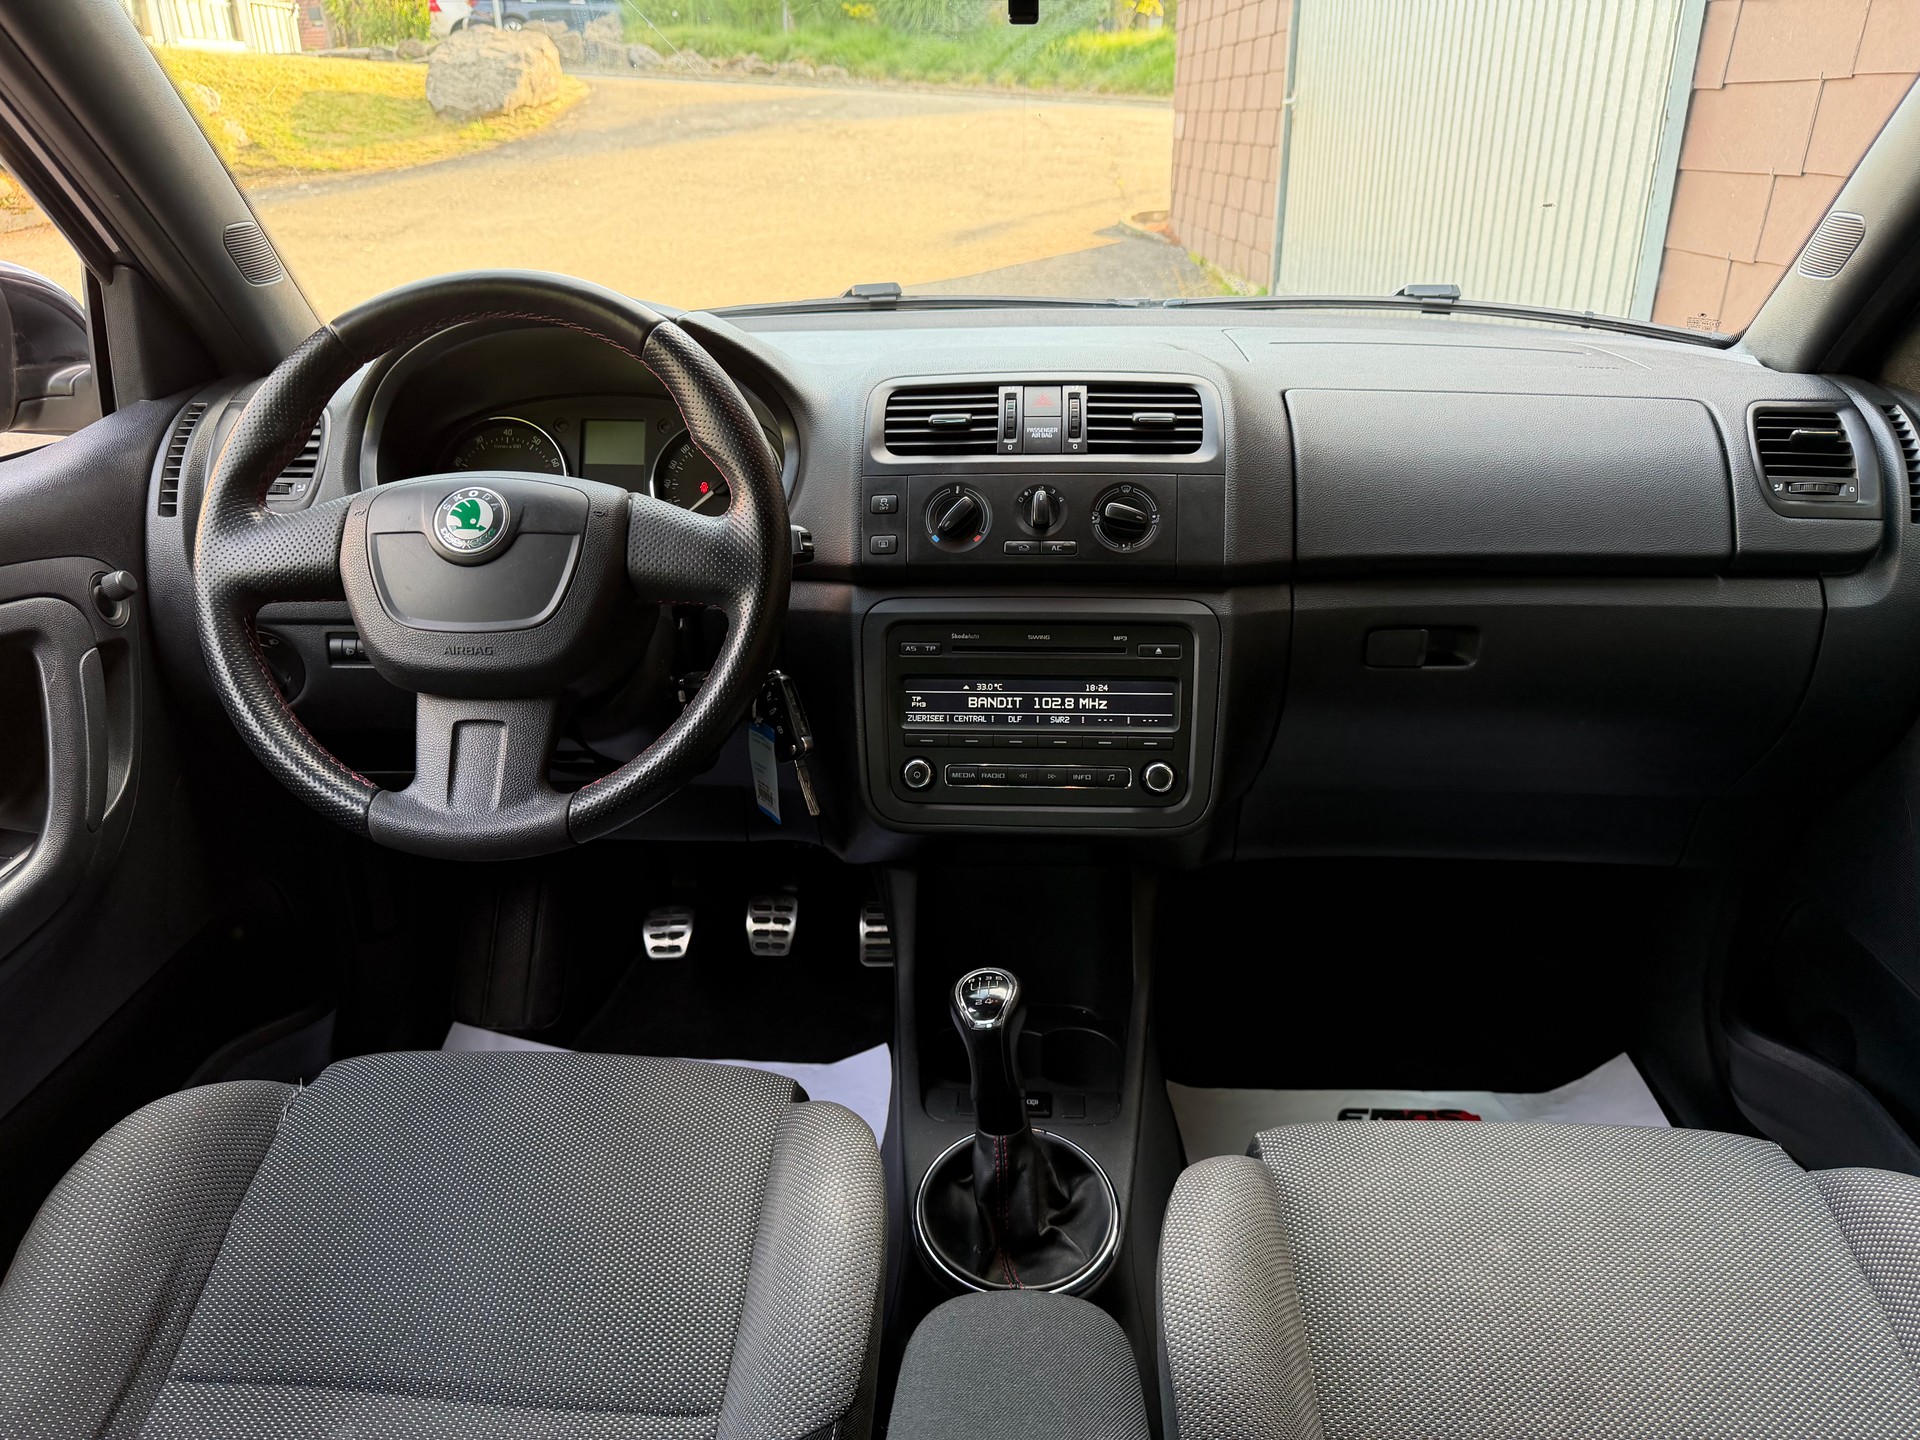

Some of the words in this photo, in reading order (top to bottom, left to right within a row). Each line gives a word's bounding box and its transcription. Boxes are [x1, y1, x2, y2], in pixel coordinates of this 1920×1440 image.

[531, 435, 541, 445] 50
[680, 444, 690, 454] 80
[550, 458, 560, 468] 60
[669, 460, 678, 470] 60
[663, 479, 671, 488] 40
[443, 646, 494, 656] AIRBAG
[968, 697, 1023, 709] BANDIT
[1033, 697, 1075, 709] 102.8
[1079, 698, 1108, 710] MHz
[907, 714, 945, 722] ZUERISEE
[953, 715, 987, 723] CENTRAL
[1049, 716, 1070, 724] SWR2
[981, 772, 1005, 780] RADIO
[1072, 773, 1092, 781] INFO
